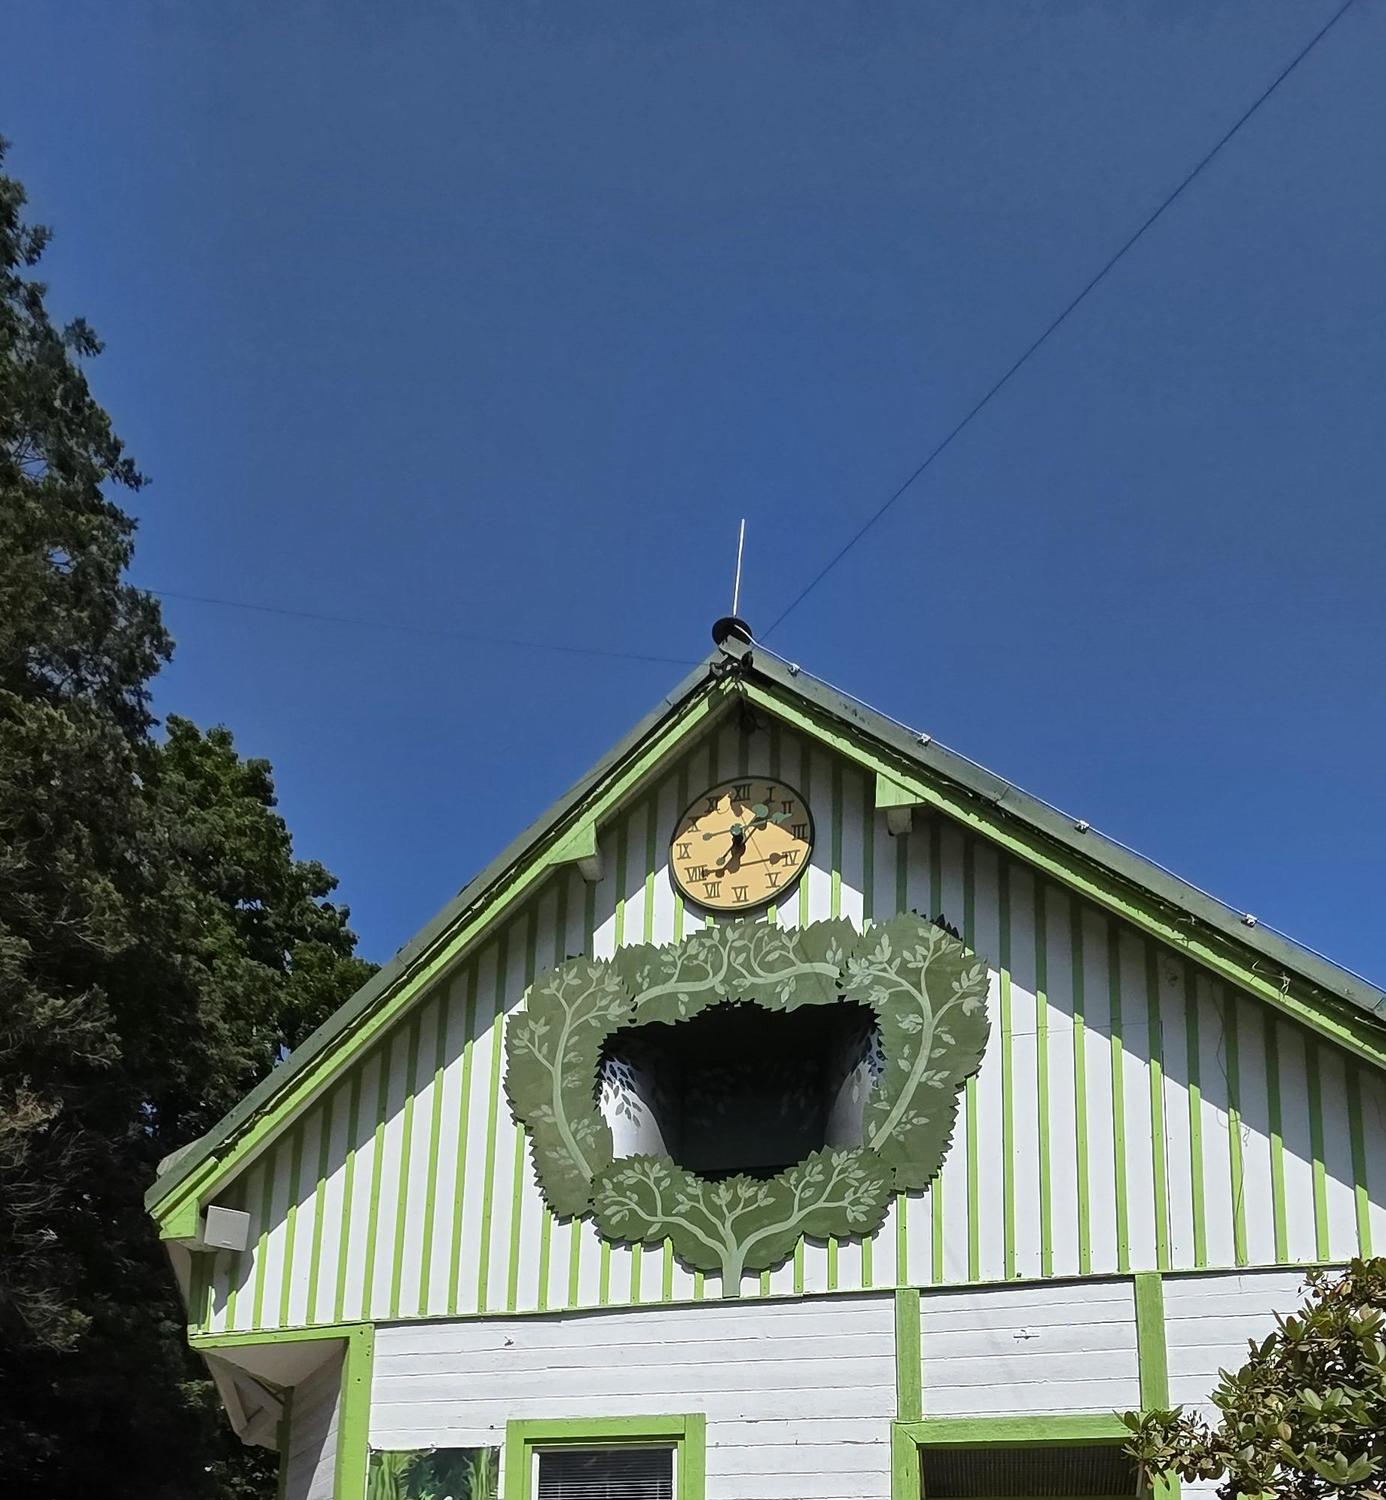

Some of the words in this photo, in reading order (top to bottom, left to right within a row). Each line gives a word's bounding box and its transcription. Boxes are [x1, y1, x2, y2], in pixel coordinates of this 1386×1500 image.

[732, 784, 752, 802] XII
[782, 801, 794, 814] II
[687, 816, 701, 833] X
[791, 823, 808, 841] III
[676, 842, 693, 860] IX
[782, 849, 801, 866] IV
[765, 872, 781, 888] V
[703, 881, 722, 899] VII
[731, 886, 749, 903] VI
